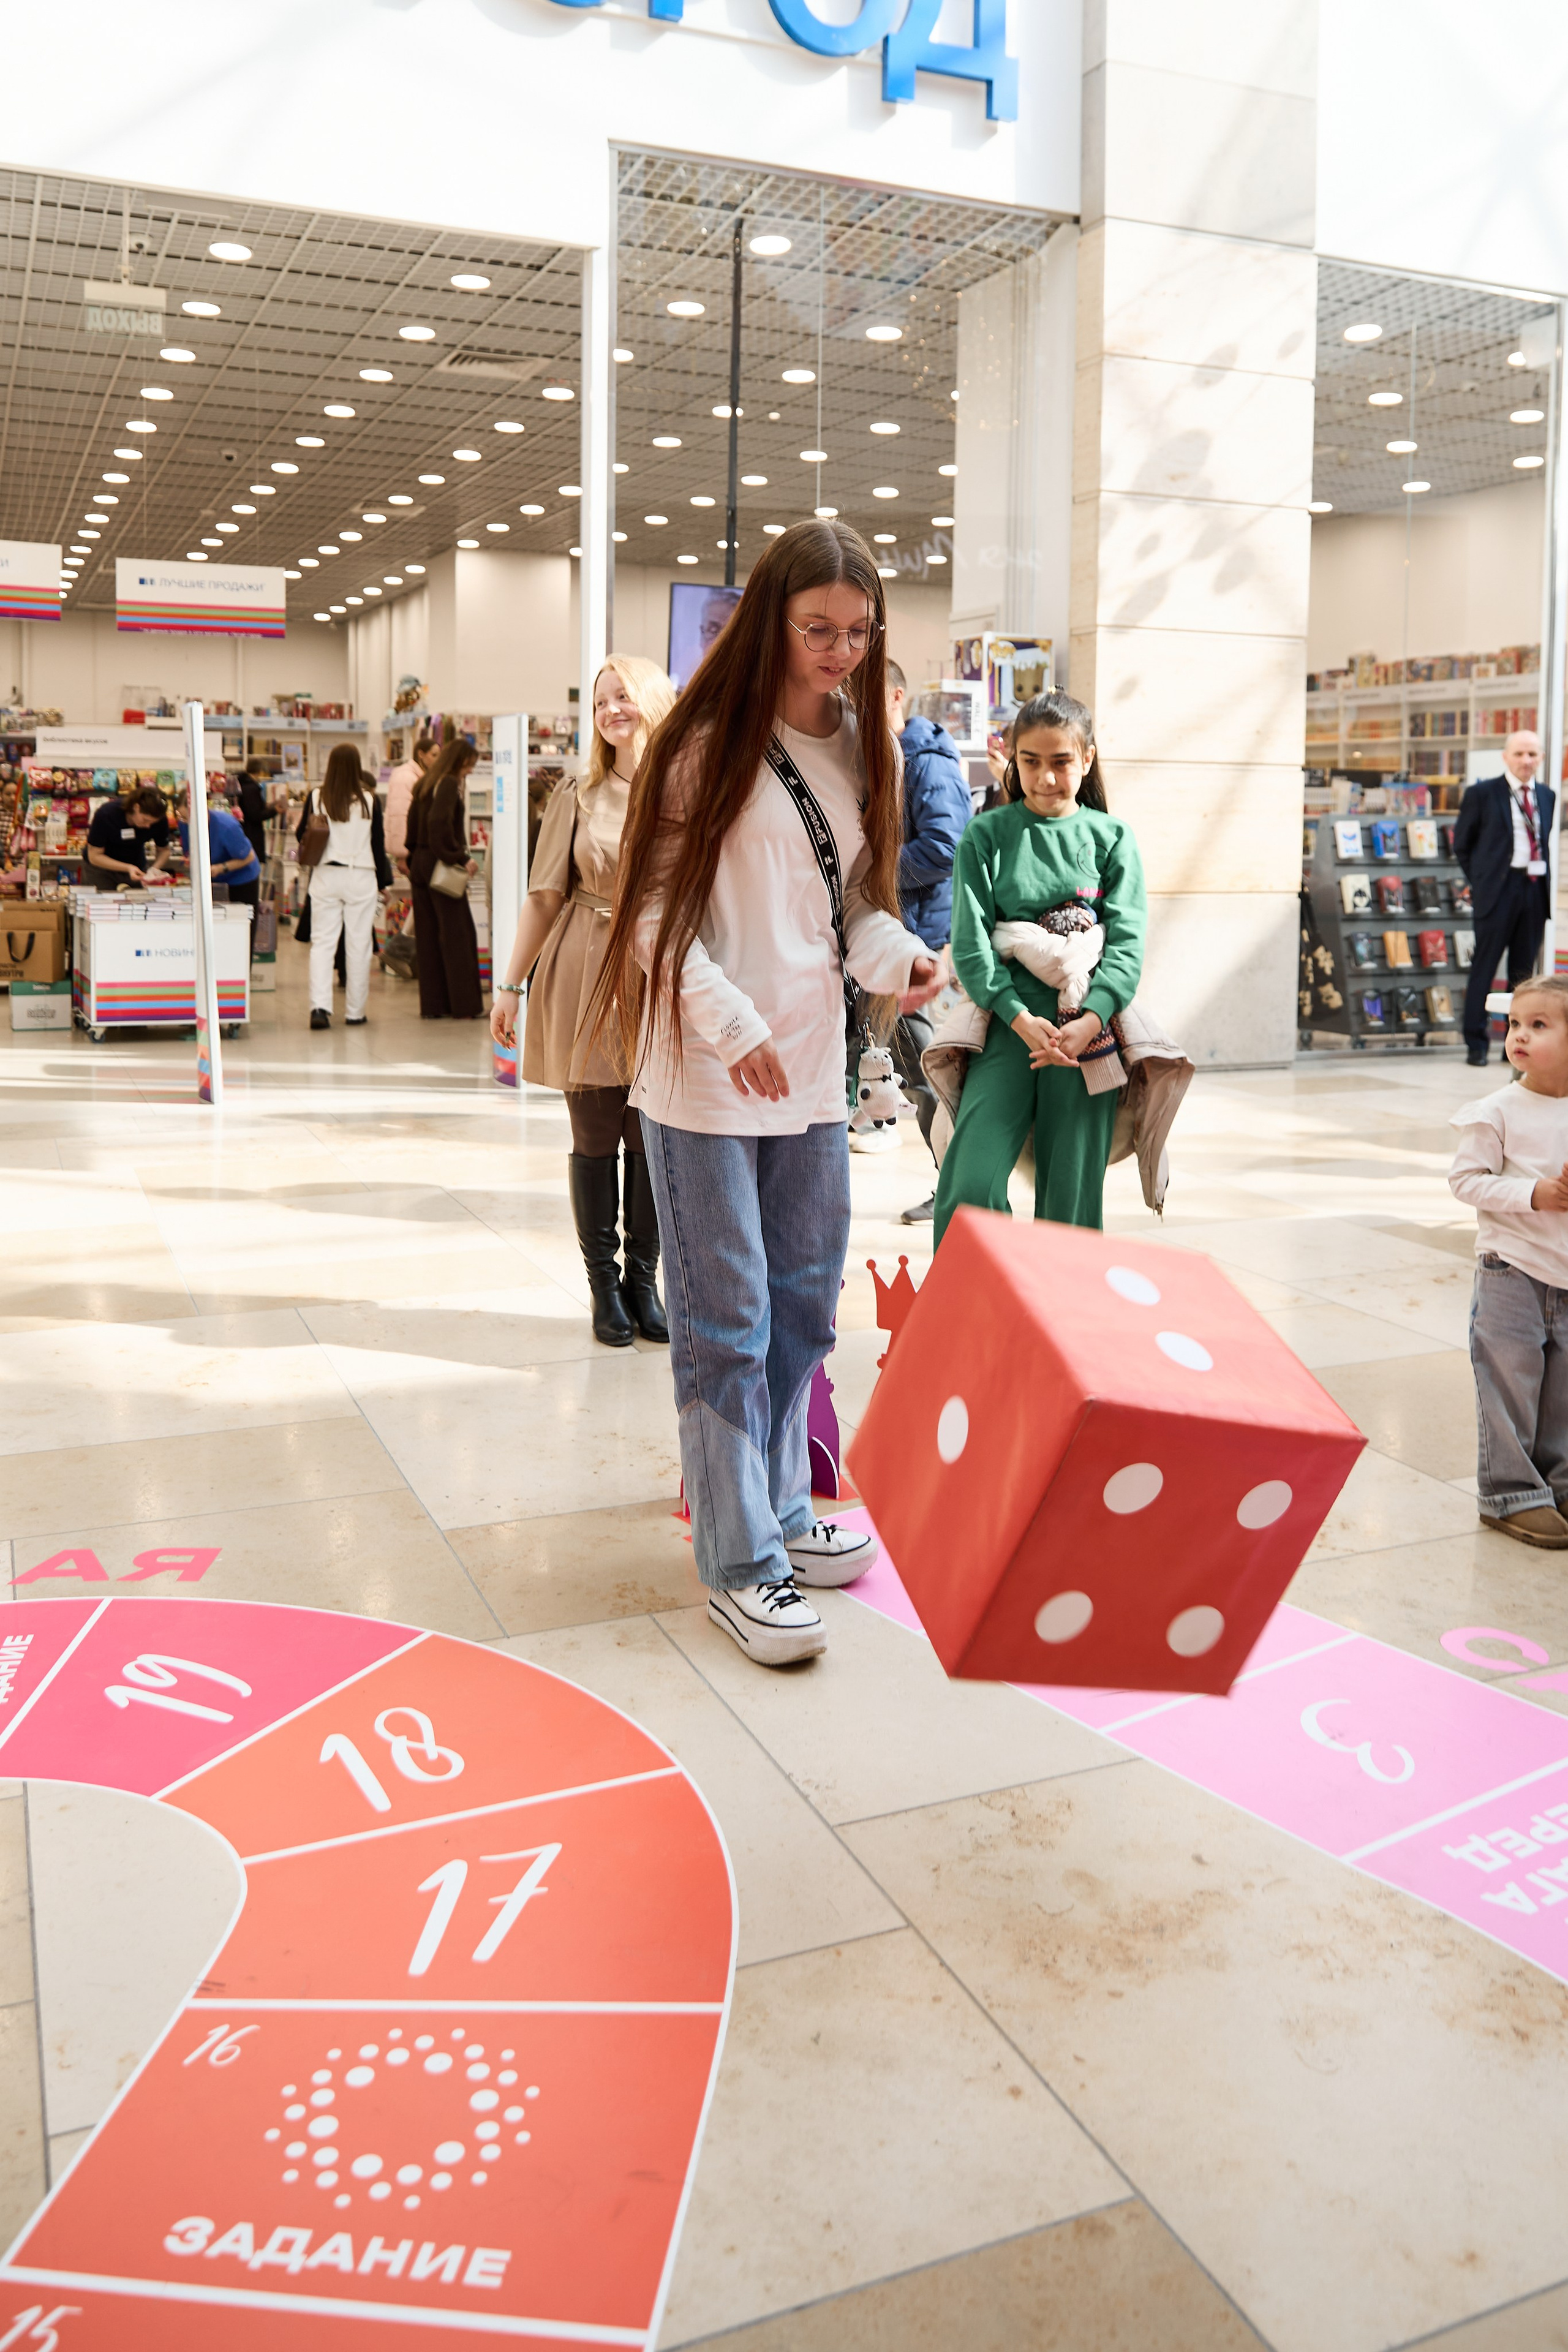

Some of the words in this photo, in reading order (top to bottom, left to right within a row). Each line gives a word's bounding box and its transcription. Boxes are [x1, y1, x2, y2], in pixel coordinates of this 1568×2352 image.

[159, 578, 205, 589] ЛУЧШИЕ
[208, 579, 266, 592] ПРОДАЖИ
[9, 1547, 222, 1585] АЯ
[104, 1653, 252, 1724] 19
[319, 1706, 465, 1813] 18
[1300, 1698, 1415, 1784] 3
[408, 1842, 563, 1977] 17
[183, 2024, 260, 2066] 16
[164, 2216, 512, 2288] ЗАДАНИЕ
[0, 2305, 82, 2352] 15
